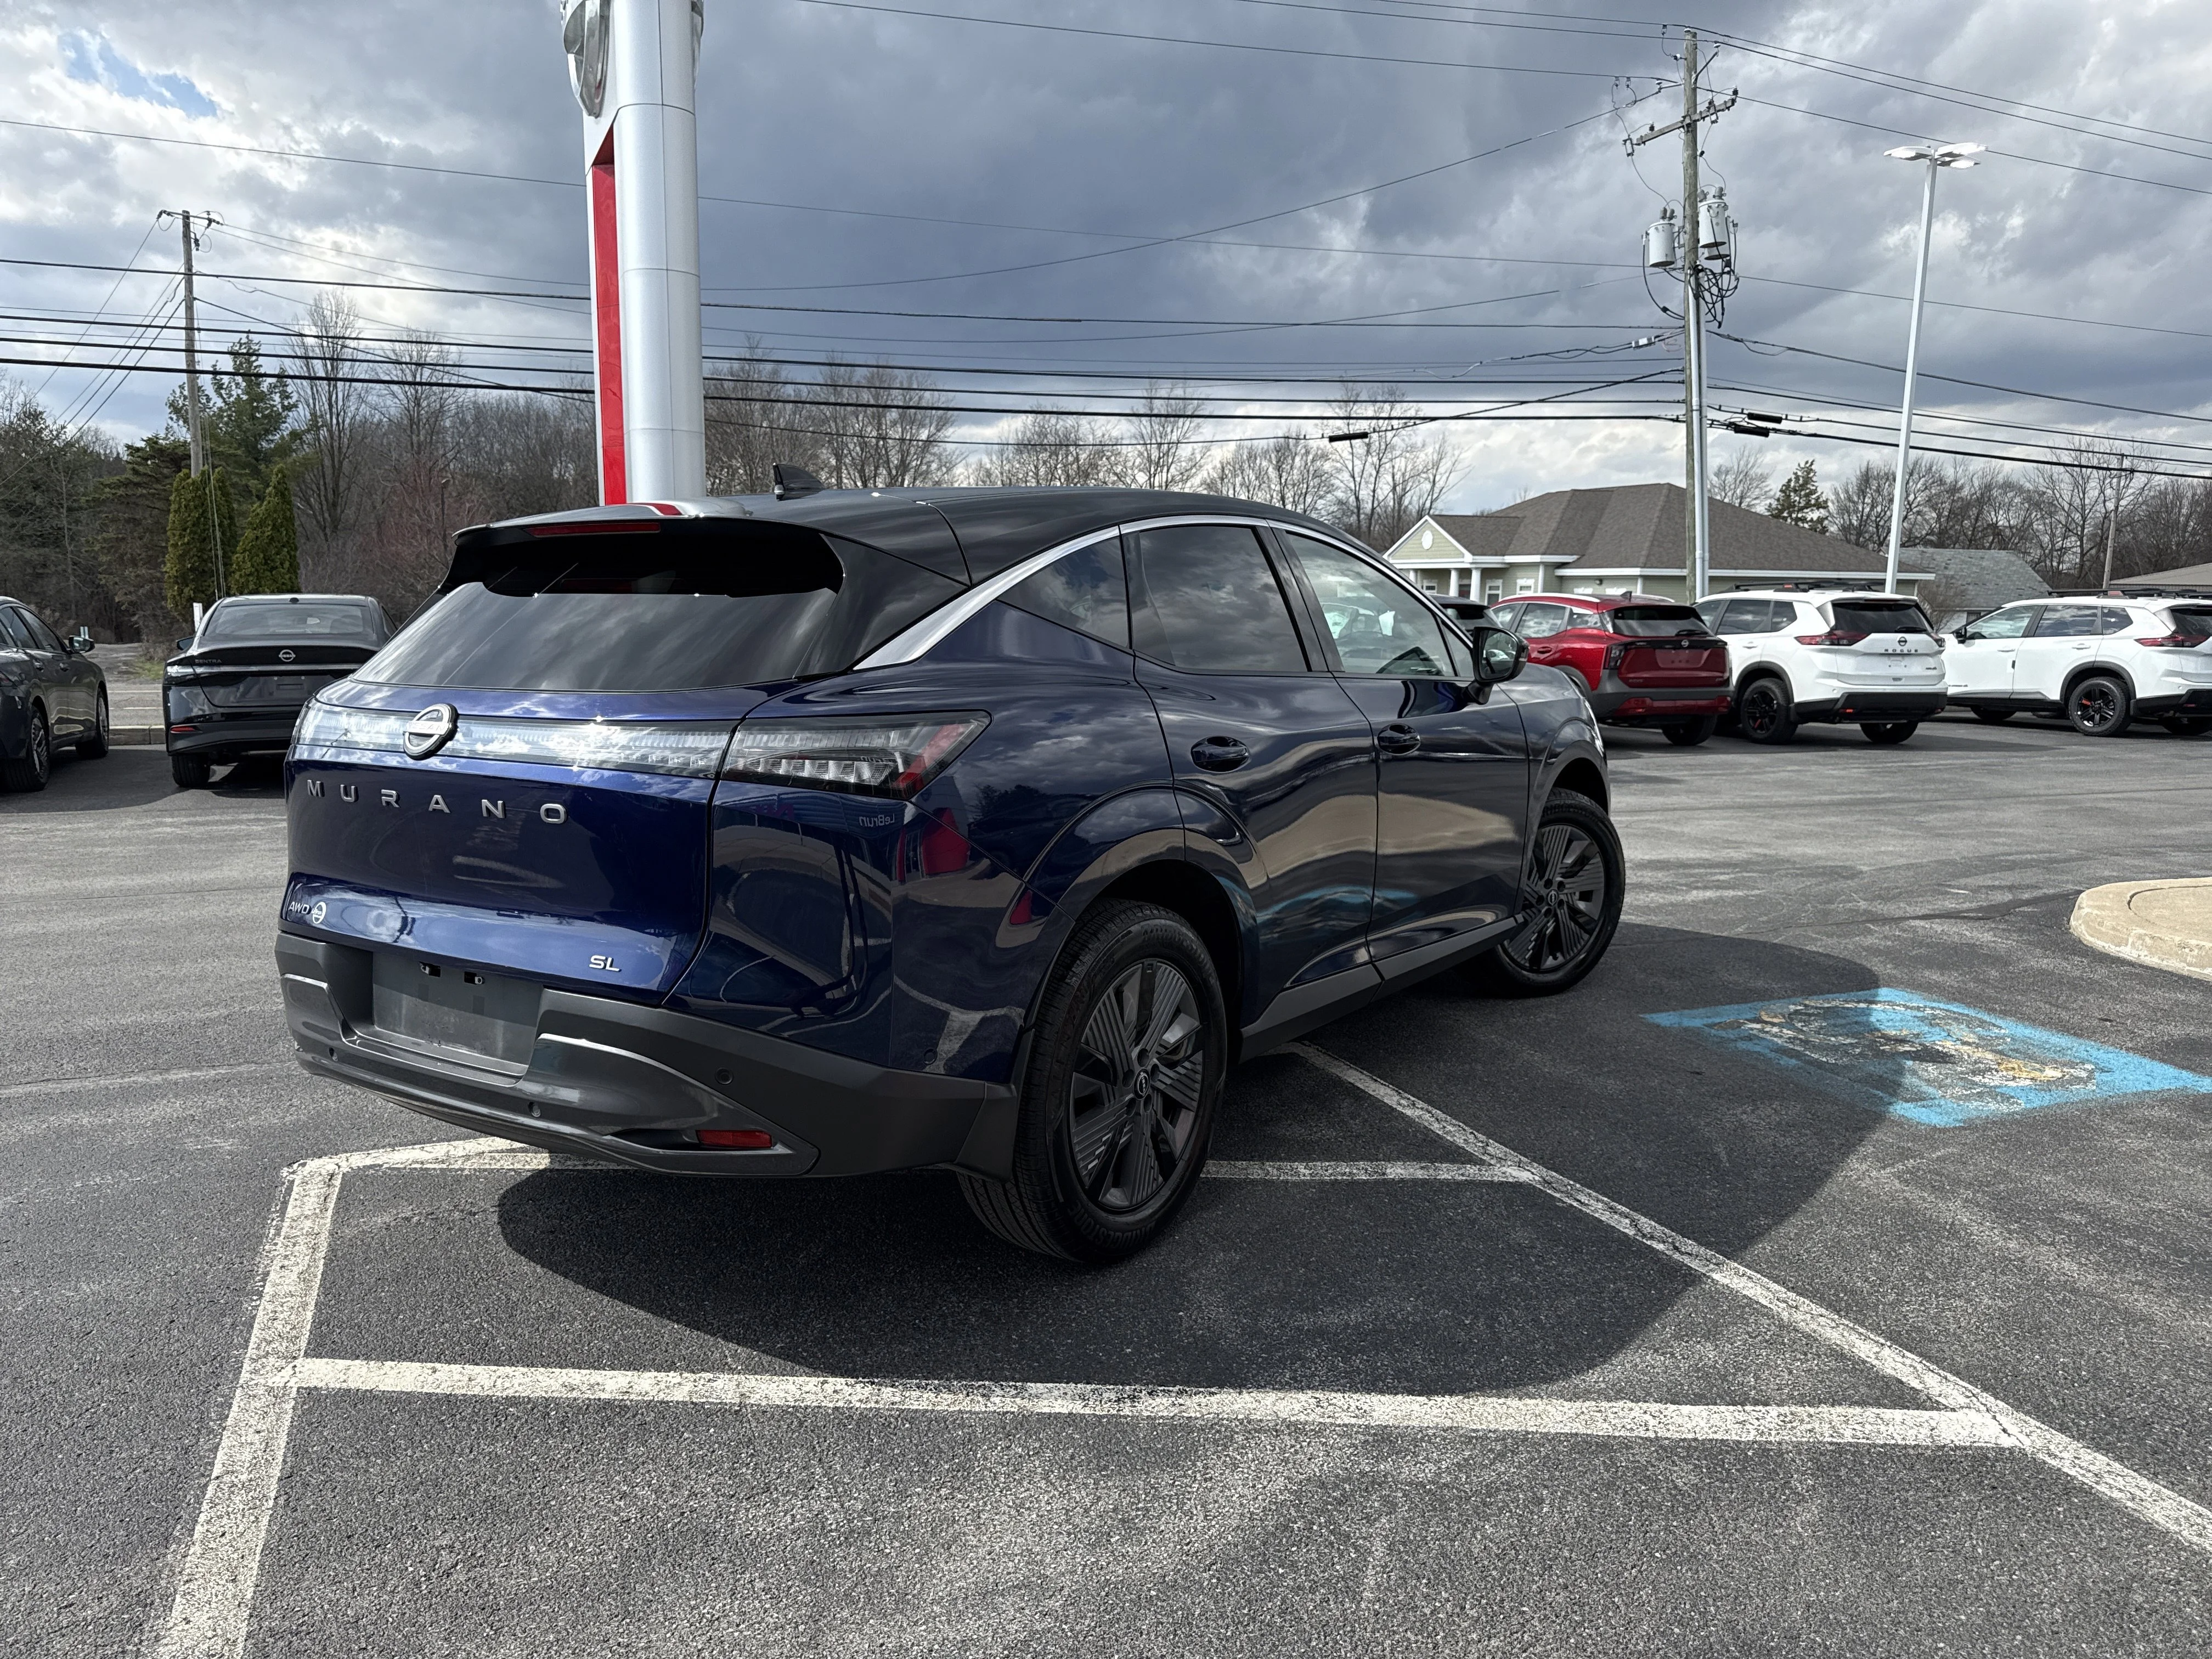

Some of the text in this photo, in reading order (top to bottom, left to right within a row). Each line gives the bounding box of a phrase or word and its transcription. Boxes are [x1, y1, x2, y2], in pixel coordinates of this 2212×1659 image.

[307, 780, 567, 824] MURANO
[288, 901, 312, 915] AWD
[589, 955, 621, 972] SL
